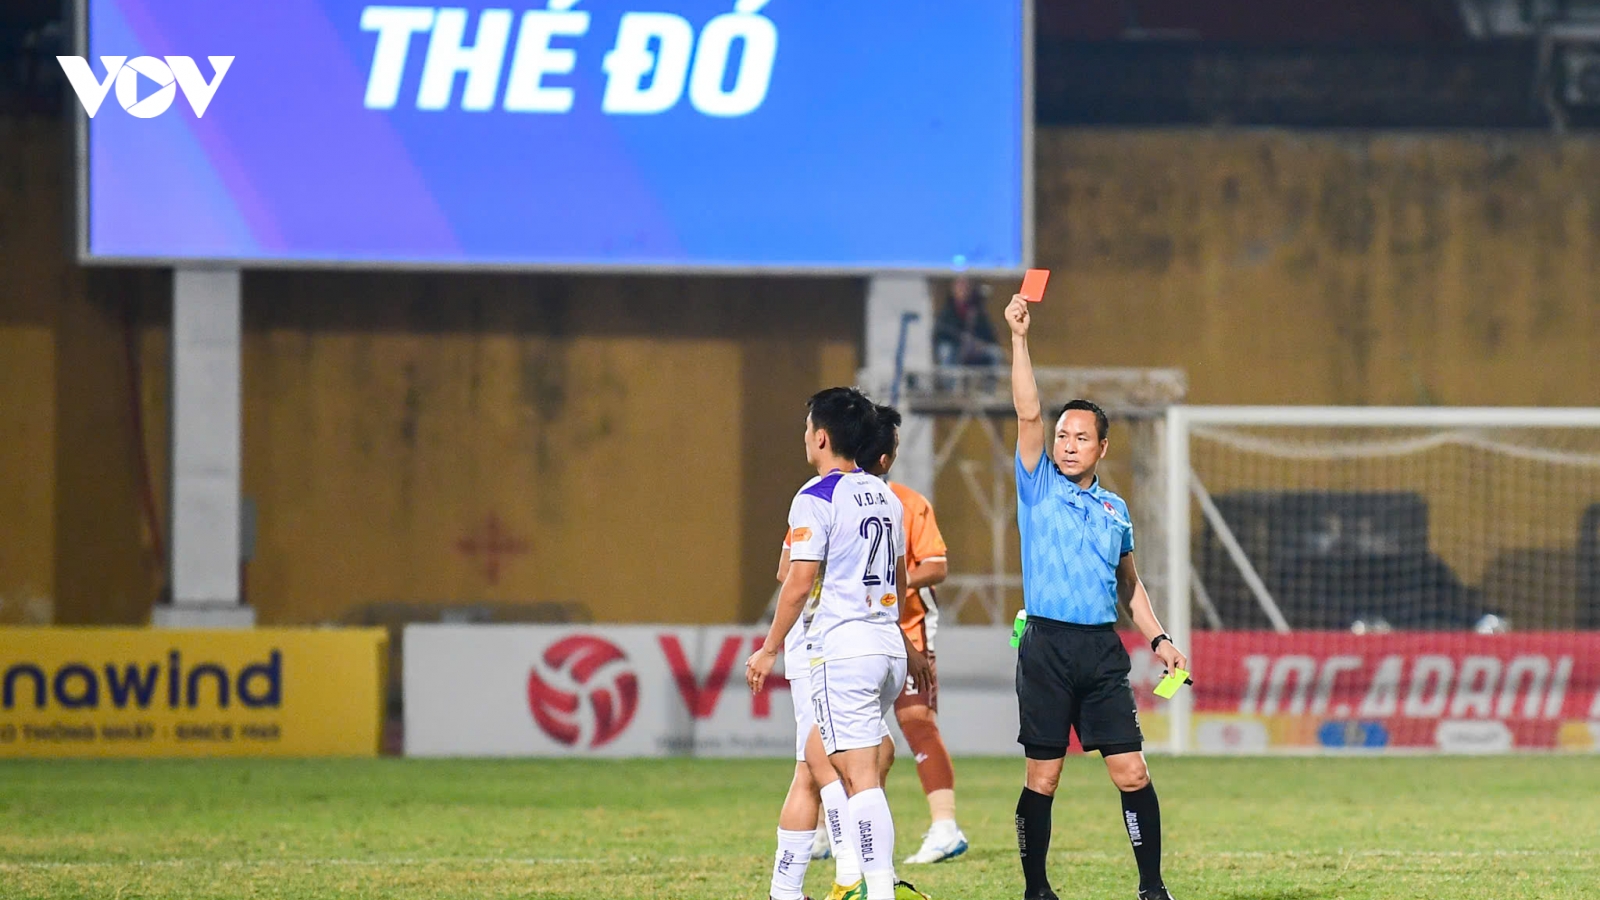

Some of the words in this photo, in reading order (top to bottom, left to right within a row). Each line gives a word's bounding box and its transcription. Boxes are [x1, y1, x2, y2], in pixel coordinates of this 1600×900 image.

[859, 516, 896, 587] 21
[3, 647, 283, 709] nawind
[827, 808, 843, 846] JOGARBOLA
[858, 819, 875, 863] JOGARBOLA
[1125, 810, 1143, 847] JOGARBOLA
